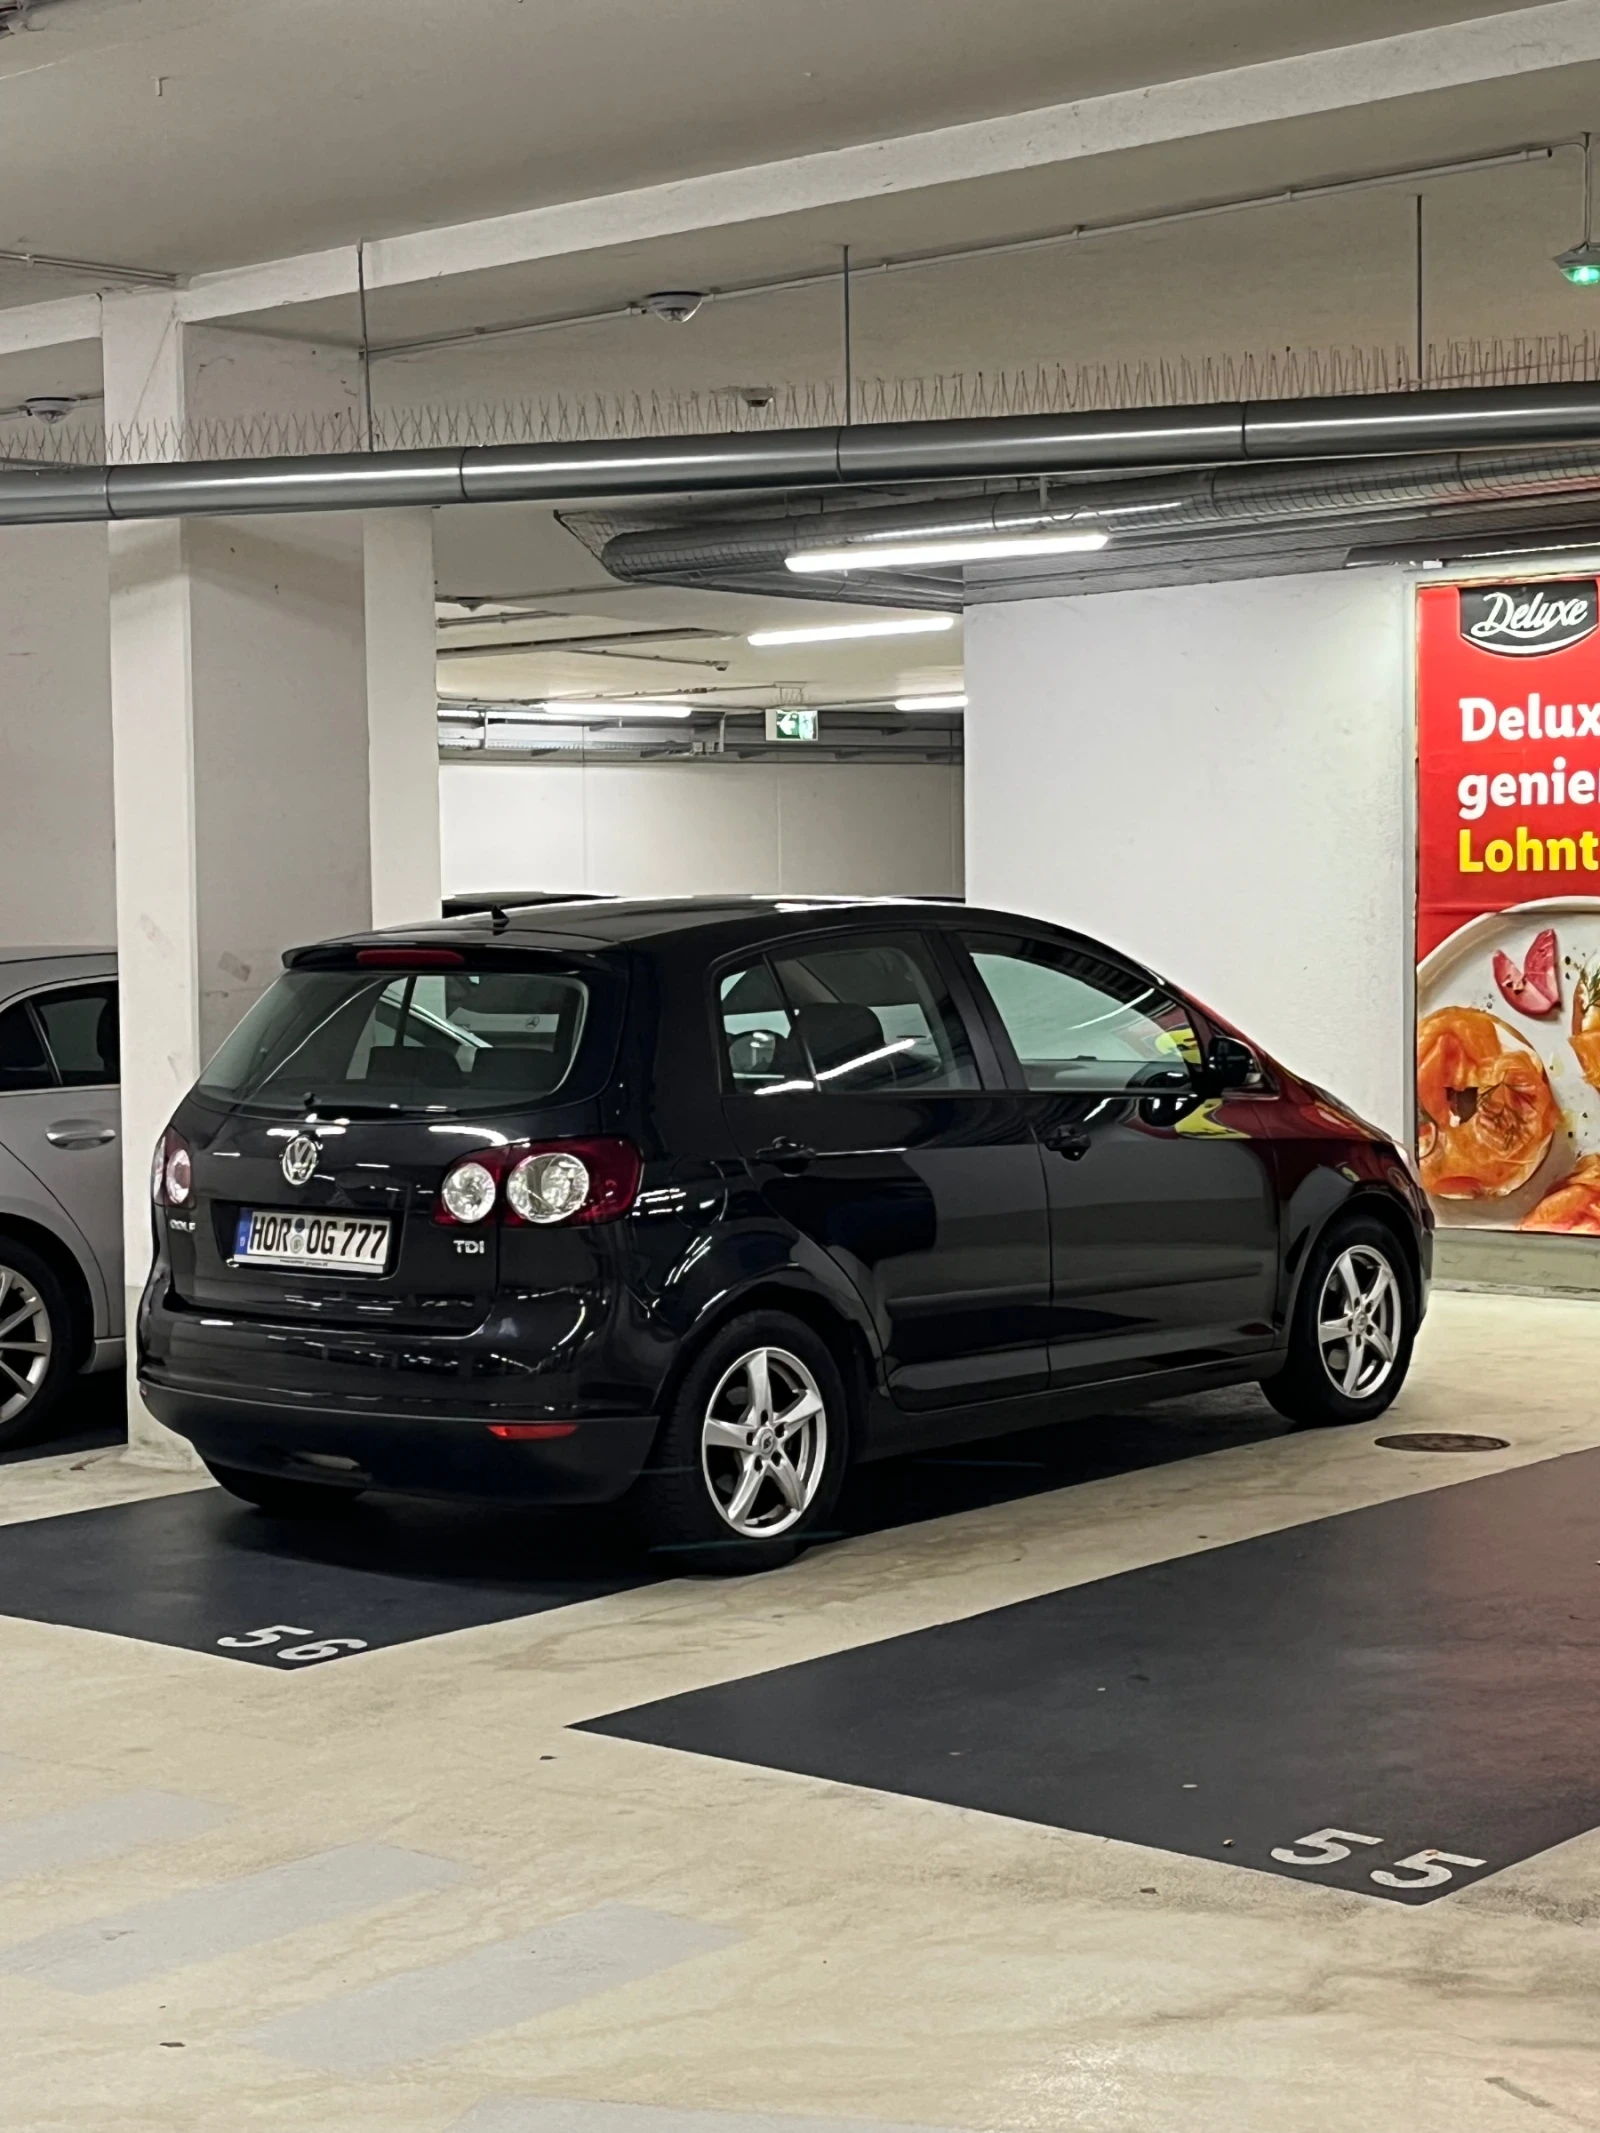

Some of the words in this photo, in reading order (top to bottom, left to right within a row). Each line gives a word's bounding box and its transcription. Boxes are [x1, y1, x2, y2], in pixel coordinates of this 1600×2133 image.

[1471, 591, 1588, 638] Deluxe
[1457, 756, 1600, 820] genie
[1459, 826, 1599, 873] Lohnt
[250, 1216, 292, 1252] HOR
[306, 1220, 337, 1254] OG
[340, 1223, 387, 1259] 777
[453, 1240, 485, 1254] TDI
[217, 1624, 368, 1661] 56
[1270, 1828, 1488, 1889] 55
